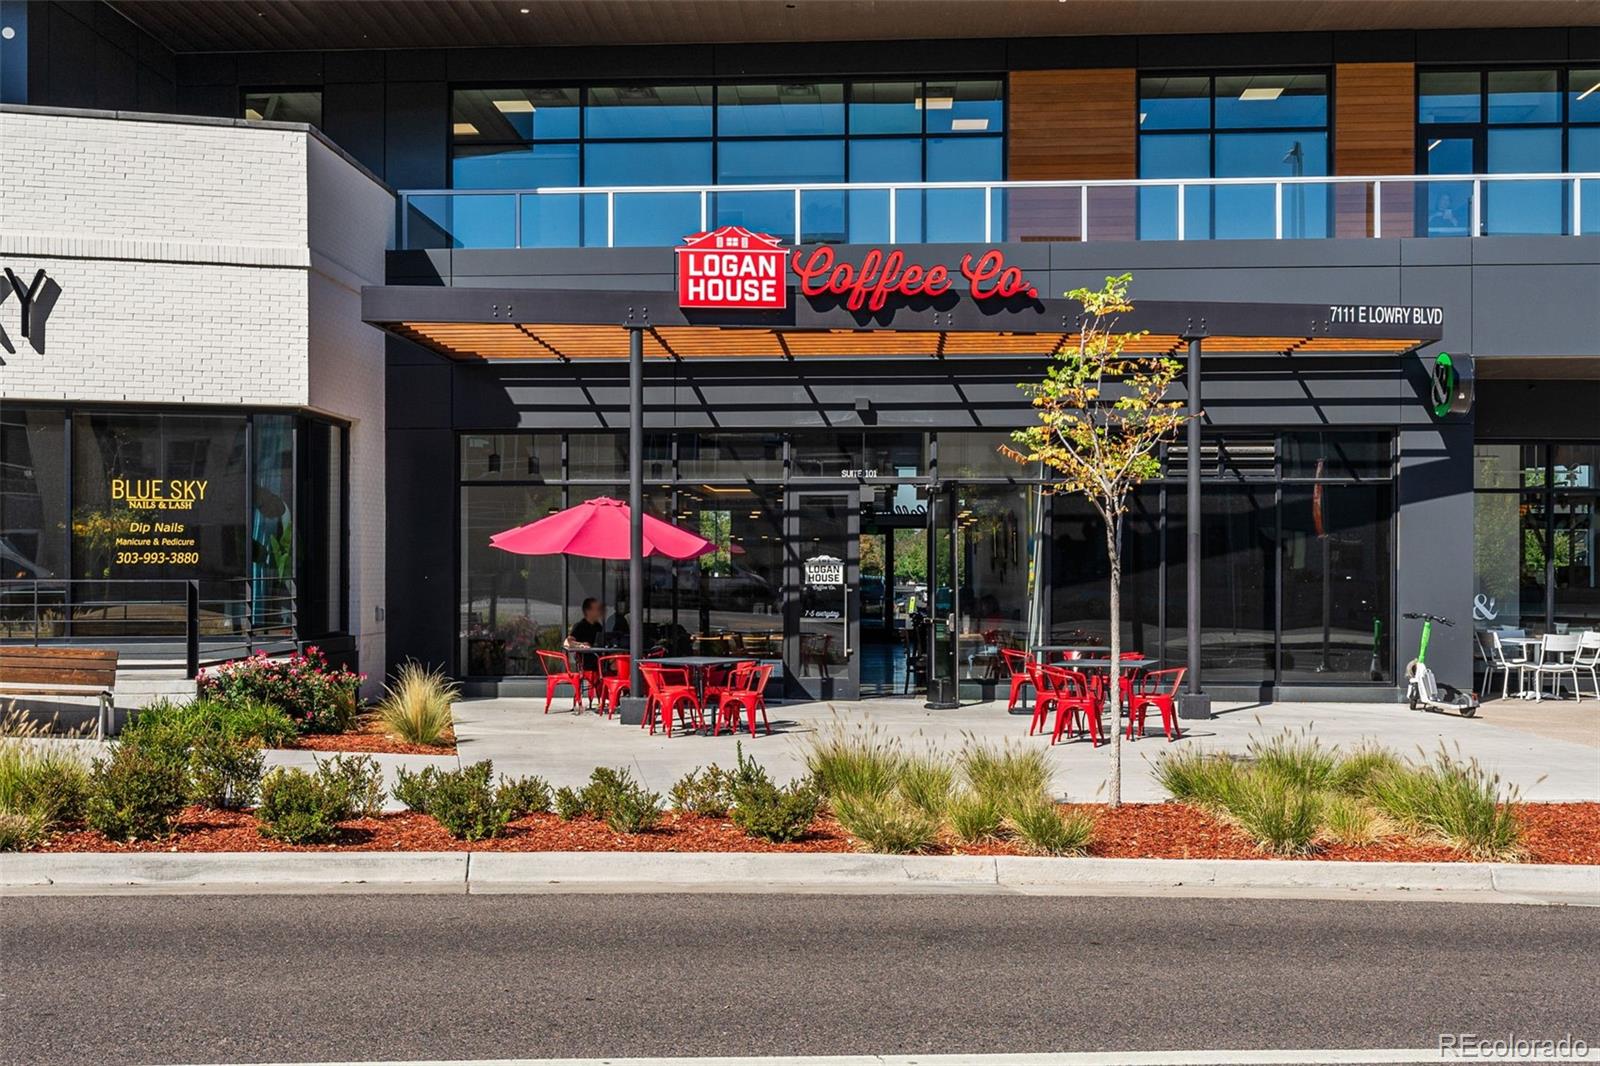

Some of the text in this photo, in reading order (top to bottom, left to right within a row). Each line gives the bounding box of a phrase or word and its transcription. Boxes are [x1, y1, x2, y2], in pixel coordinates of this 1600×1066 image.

[688, 254, 776, 277] LOGAN
[791, 246, 1038, 311] Coffee Co.
[688, 279, 776, 302] HOUSE
[1330, 306, 1443, 325] 7111 E LOWRY BLVD
[841, 469, 877, 478] SUITE 101
[112, 479, 208, 500] BLUE SKY
[129, 501, 192, 510] NAILS & LASH
[129, 522, 184, 534] Dip Nails
[115, 538, 151, 546] Manicure
[161, 538, 195, 546] Pedicure
[116, 552, 199, 564] 303-993-3880
[808, 565, 840, 574] LOGAN
[808, 573, 840, 582] HOUSE
